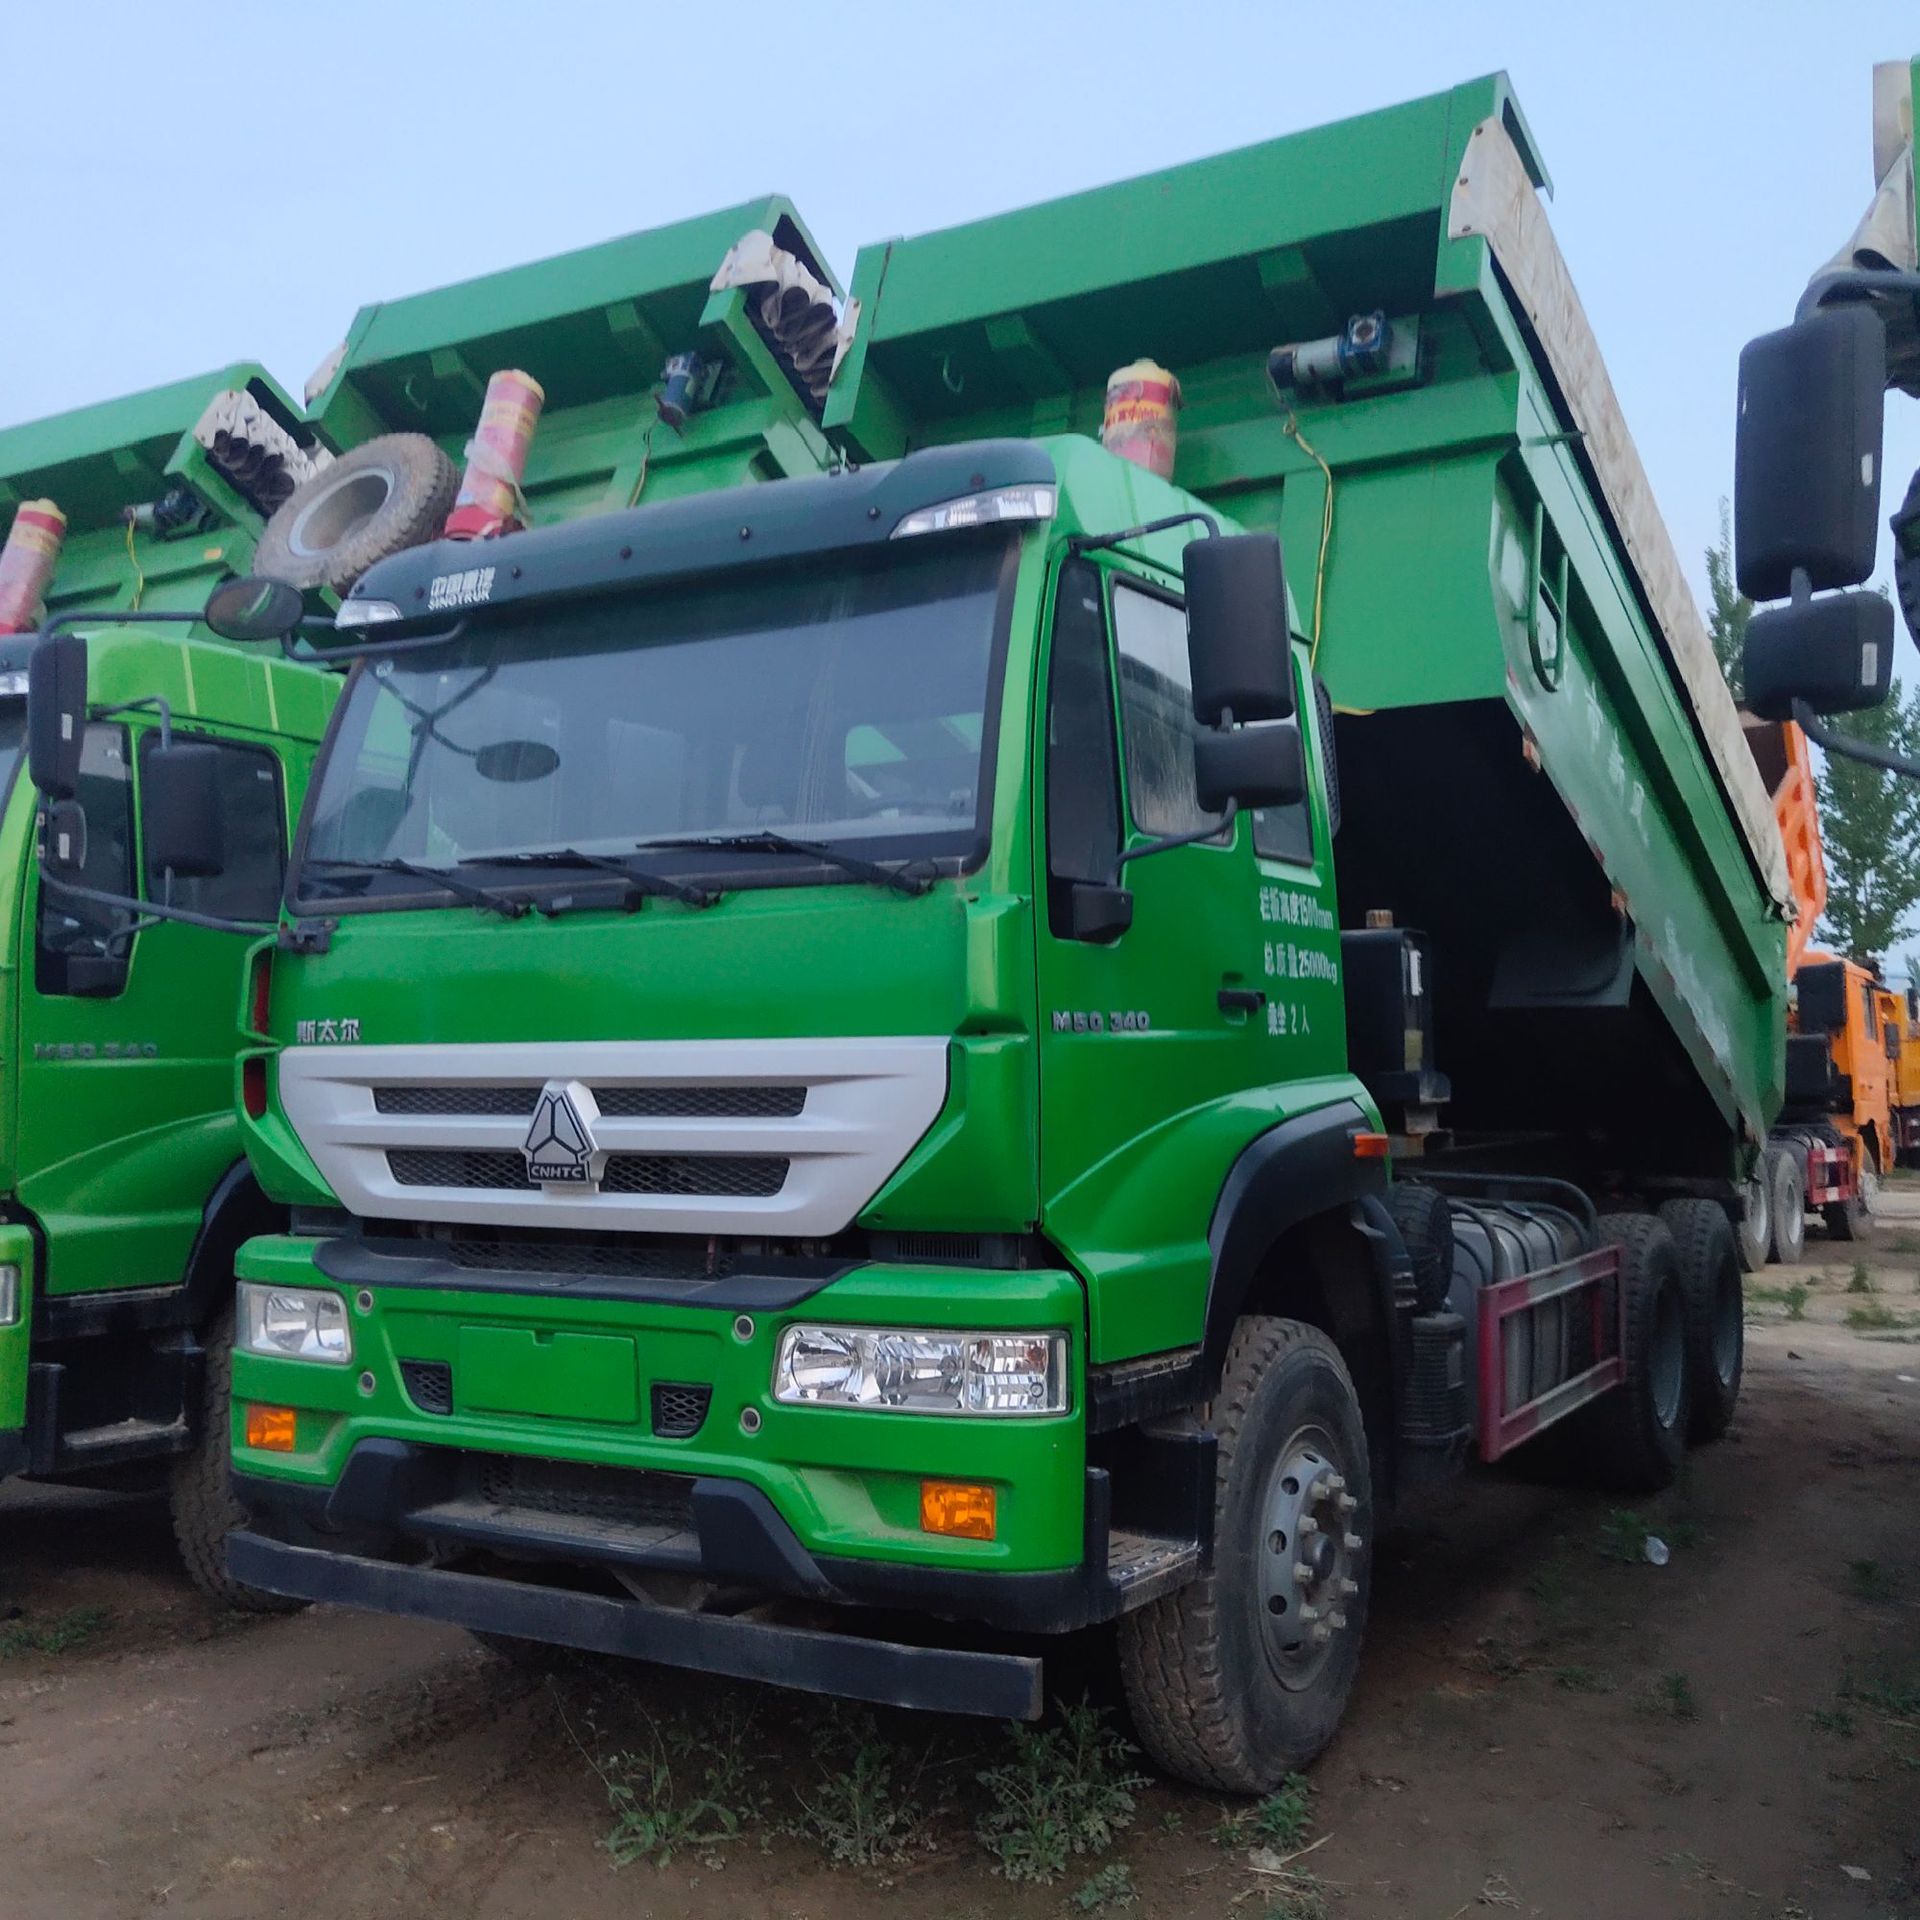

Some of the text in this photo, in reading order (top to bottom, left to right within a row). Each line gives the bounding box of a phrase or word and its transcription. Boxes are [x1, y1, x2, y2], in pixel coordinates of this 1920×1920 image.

[297, 1018, 360, 1043] 斯太尔
[1109, 1010, 1150, 1033] 340
[531, 1165, 582, 1178] CNHTC
